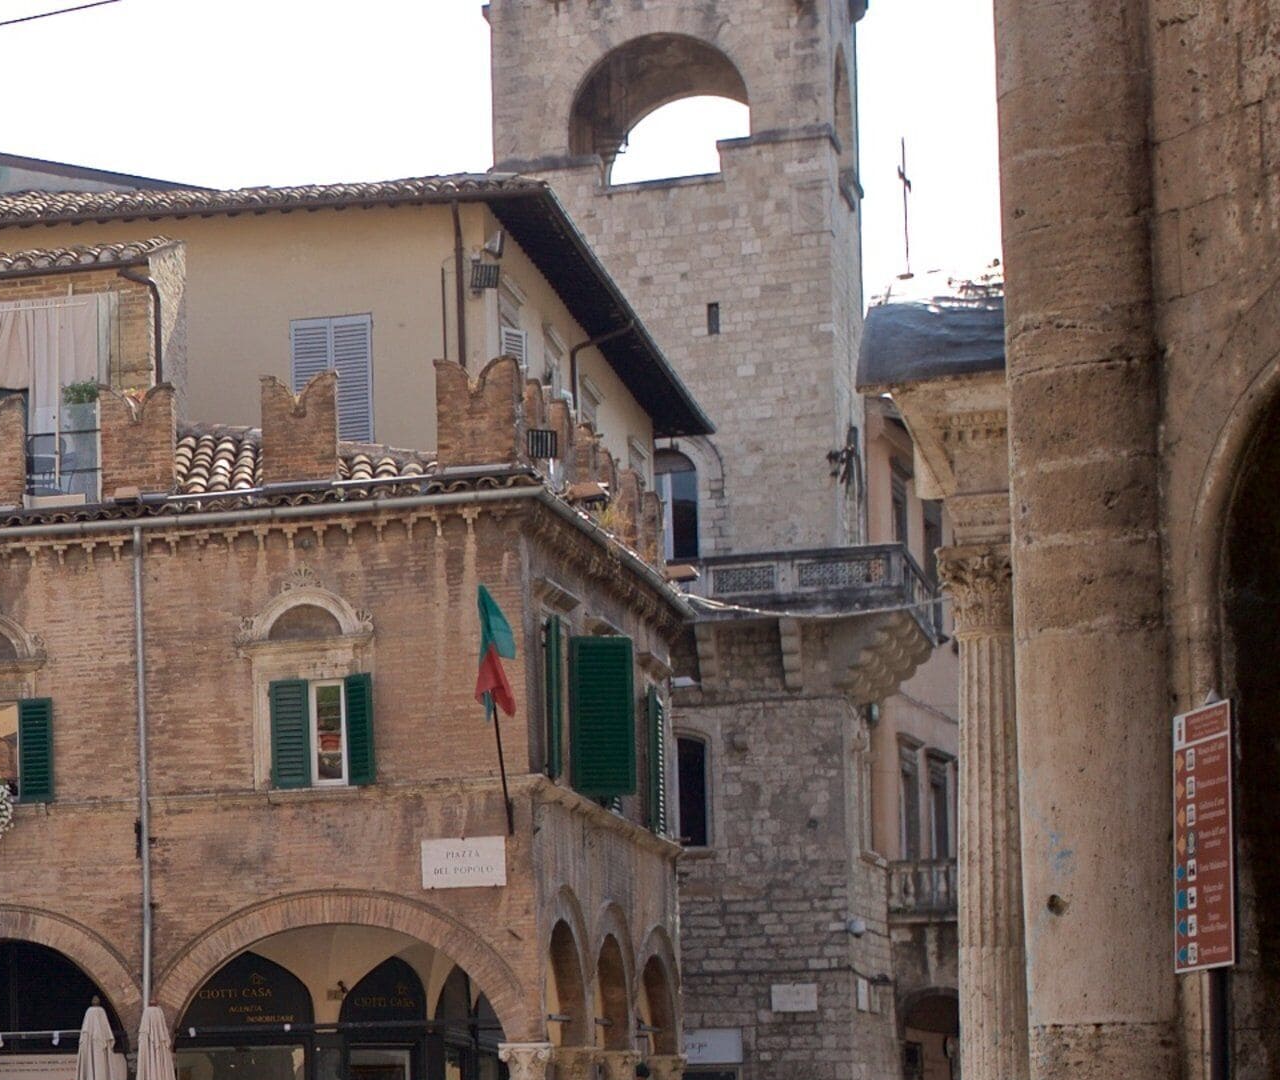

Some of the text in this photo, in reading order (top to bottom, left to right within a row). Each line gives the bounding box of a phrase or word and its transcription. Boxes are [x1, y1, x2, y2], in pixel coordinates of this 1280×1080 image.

[446, 849, 480, 859] PIAZZA
[433, 864, 494, 875] DEL POPOLO
[242, 986, 273, 997] CASA
